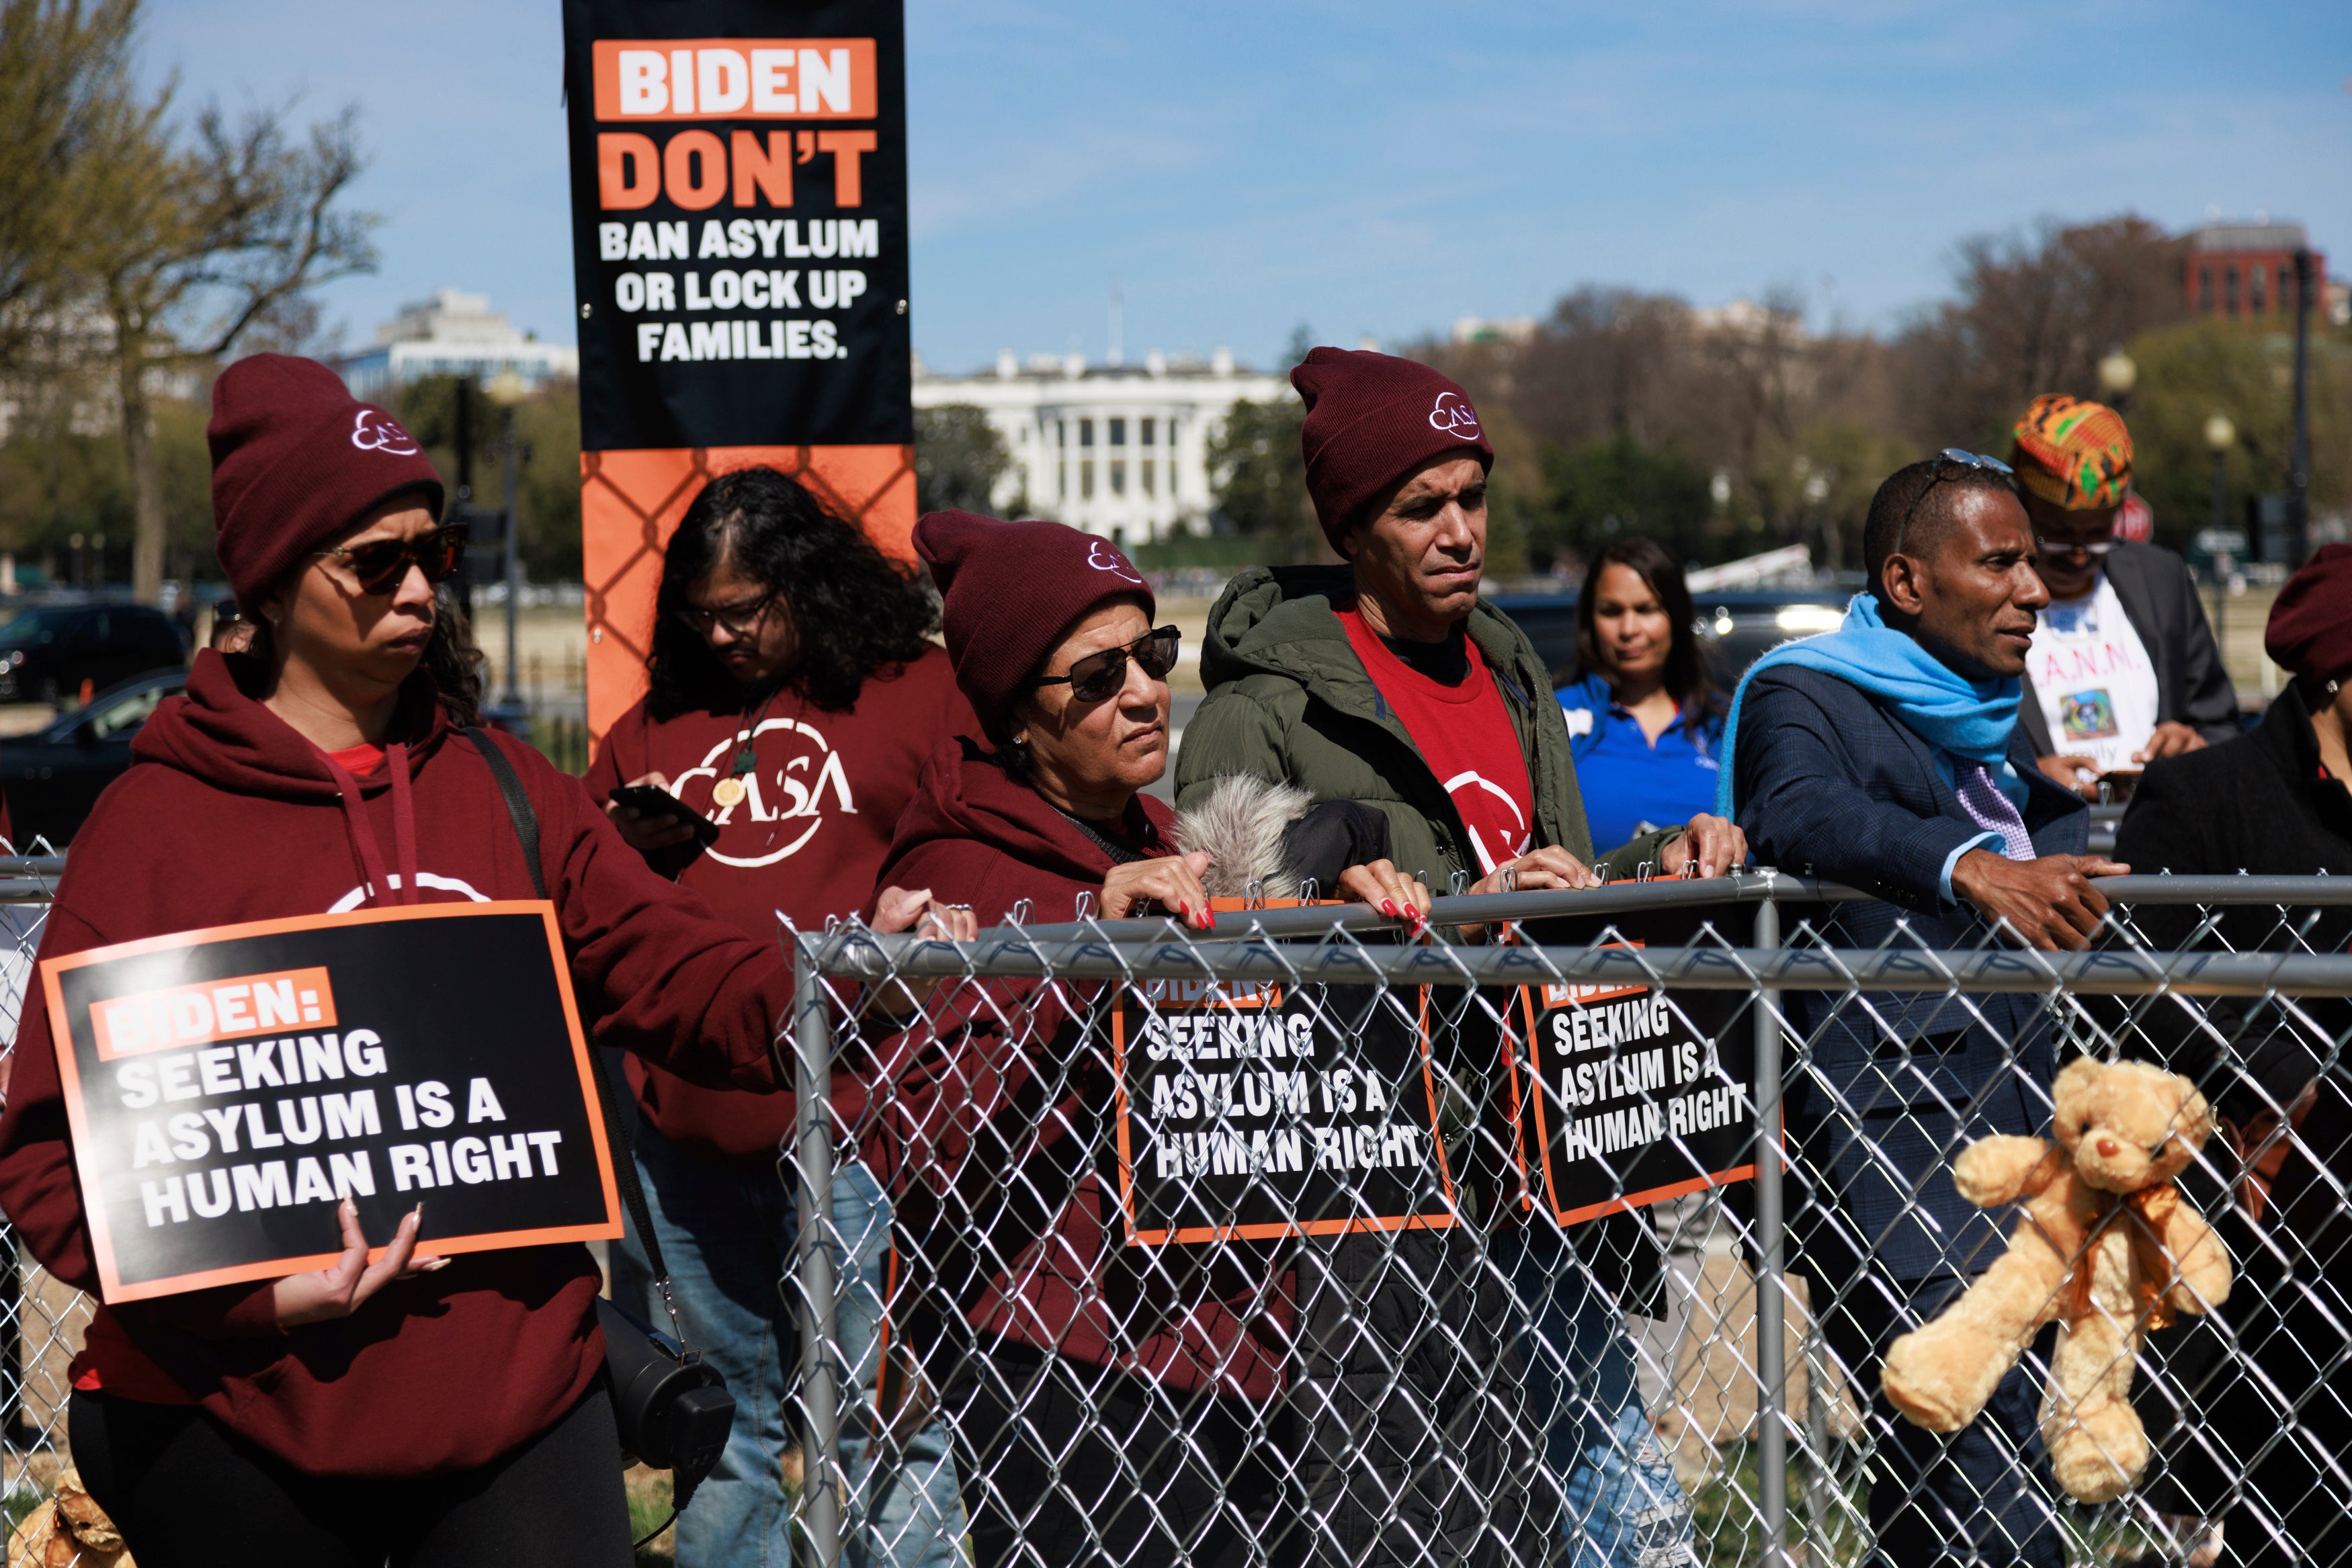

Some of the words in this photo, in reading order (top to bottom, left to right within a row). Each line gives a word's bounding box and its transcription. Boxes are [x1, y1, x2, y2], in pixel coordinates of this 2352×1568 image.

[619, 48, 851, 114] BIDEN
[597, 129, 878, 211] DON’T
[599, 221, 689, 261] BAN
[698, 218, 879, 260] ASYLUM
[615, 271, 677, 312] OR
[684, 269, 802, 310] LOCK
[808, 269, 867, 309] UP
[638, 320, 847, 362] FAMILIES.
[105, 978, 322, 1053] BIDEN:
[1146, 1013, 1315, 1061] SEEKING
[1552, 996, 1669, 1055] SEEKING
[116, 1028, 388, 1109] SEEKING
[1151, 1070, 1310, 1120] ASYLUM
[1320, 1068, 1357, 1113] IS
[1365, 1069, 1386, 1113] A
[1560, 1048, 1666, 1110] ASYLUM
[1672, 1041, 1699, 1085] IS
[1704, 1038, 1720, 1078] A
[133, 1089, 381, 1170] ASYLUM
[395, 1080, 455, 1131] IS
[467, 1078, 506, 1123] A
[1154, 1129, 1303, 1178] HUMAN
[1314, 1125, 1420, 1171] RIGHT
[1564, 1101, 1663, 1163] HUMAN
[1668, 1083, 1747, 1138] RIGHT
[140, 1150, 376, 1228] HUMAN
[389, 1131, 562, 1192] RIGHT
